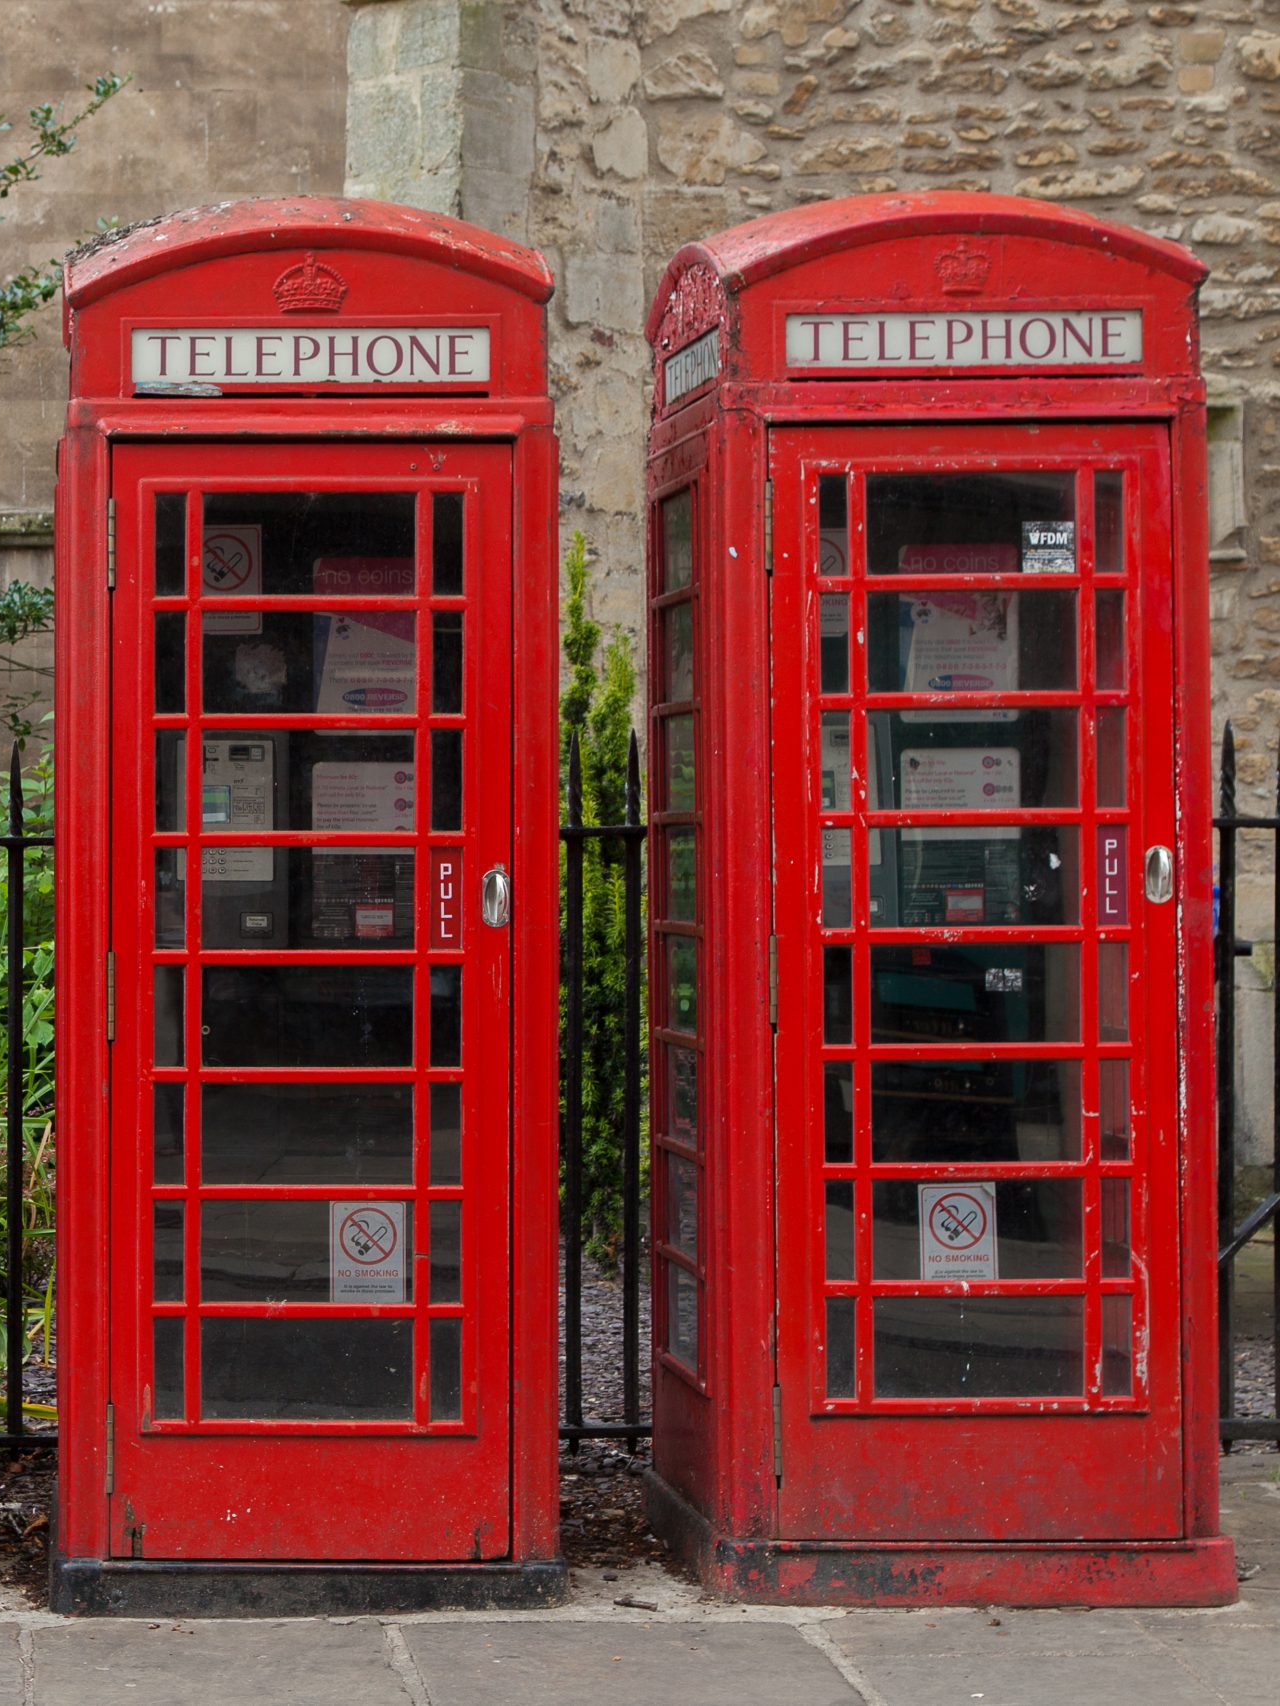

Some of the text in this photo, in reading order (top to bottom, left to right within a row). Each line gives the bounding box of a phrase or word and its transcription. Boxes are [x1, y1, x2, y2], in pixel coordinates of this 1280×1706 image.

[147, 334, 475, 377] TELEPHONE
[800, 316, 1127, 361] TELEPHONE
[667, 333, 720, 404] TELEPHON
[324, 565, 414, 585] no coins
[910, 551, 1000, 571] no coins
[1105, 839, 1118, 914] PULL
[440, 863, 453, 938] PULL
[338, 1269, 399, 1278] NO SMOKING
[928, 1254, 990, 1263] NO SMOKING
